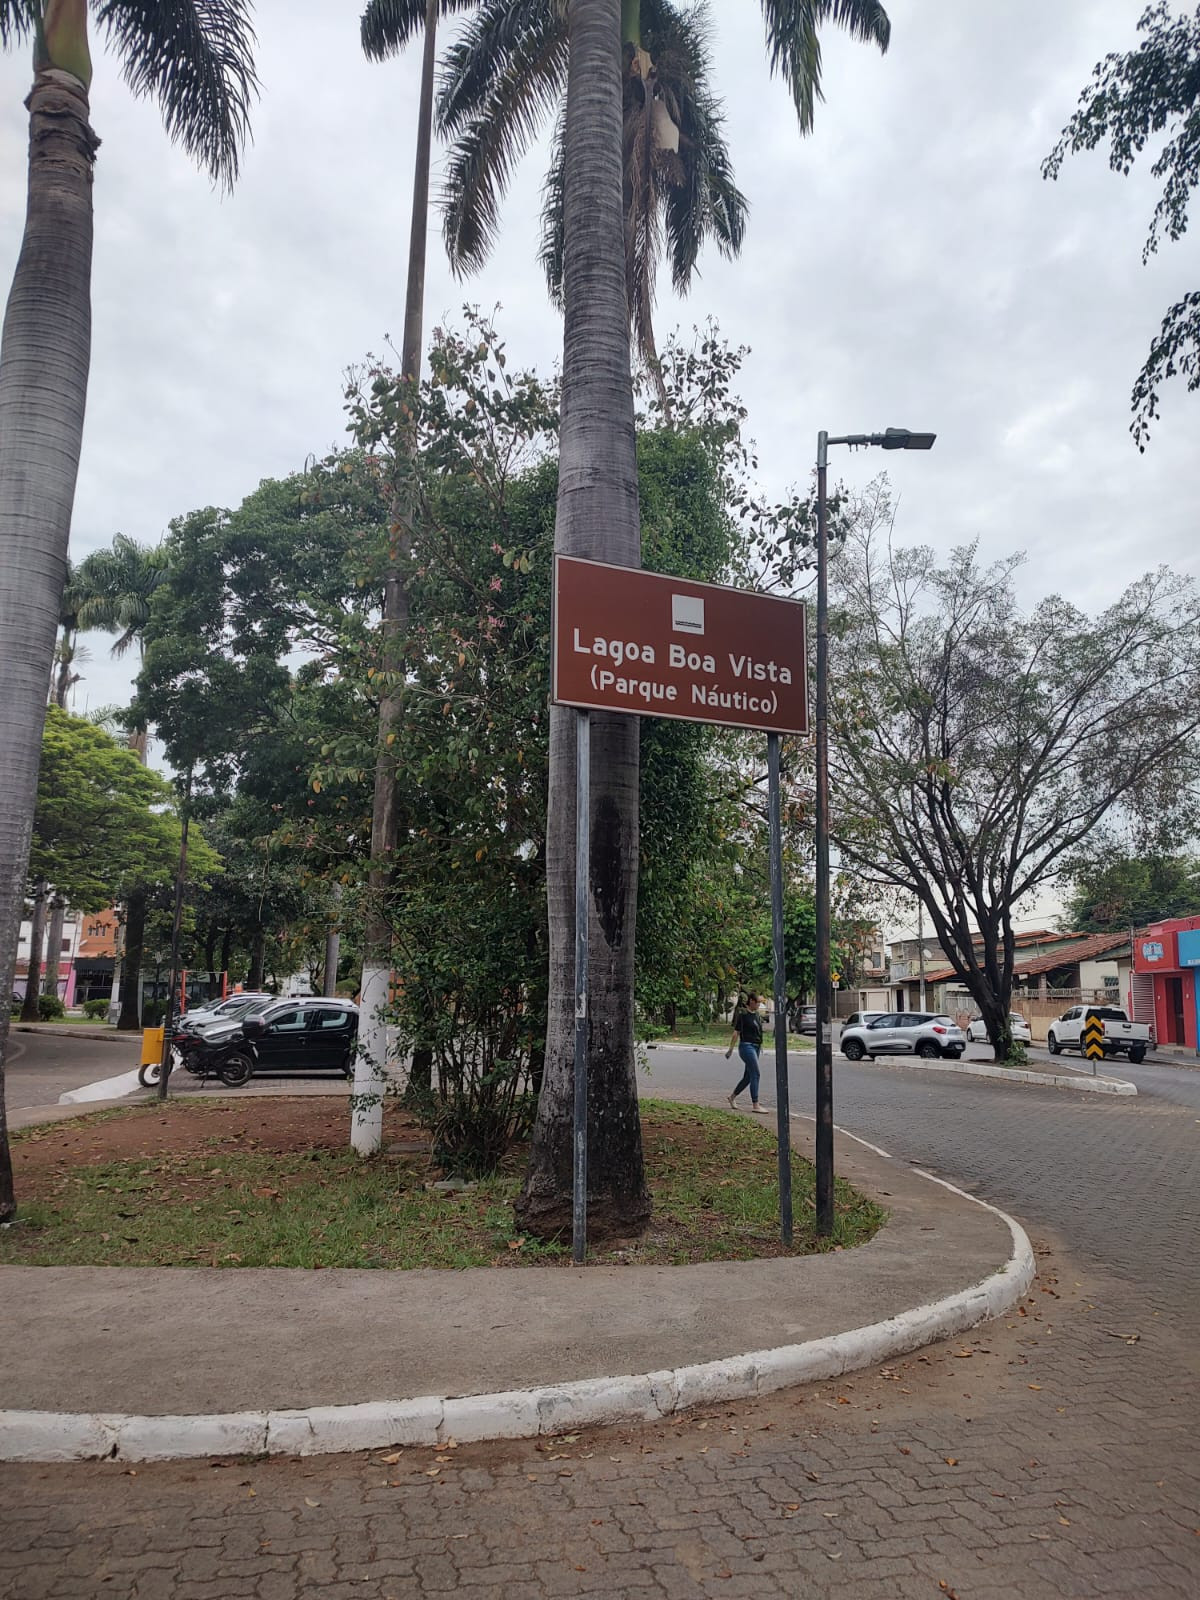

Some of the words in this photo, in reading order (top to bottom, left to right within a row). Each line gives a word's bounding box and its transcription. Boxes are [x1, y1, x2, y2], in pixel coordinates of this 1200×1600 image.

[573, 628, 655, 666] Lagoa
[669, 644, 716, 673] Boa
[729, 654, 792, 685] Vista
[590, 664, 678, 702] (Parque
[691, 685, 778, 714] Náutico)
